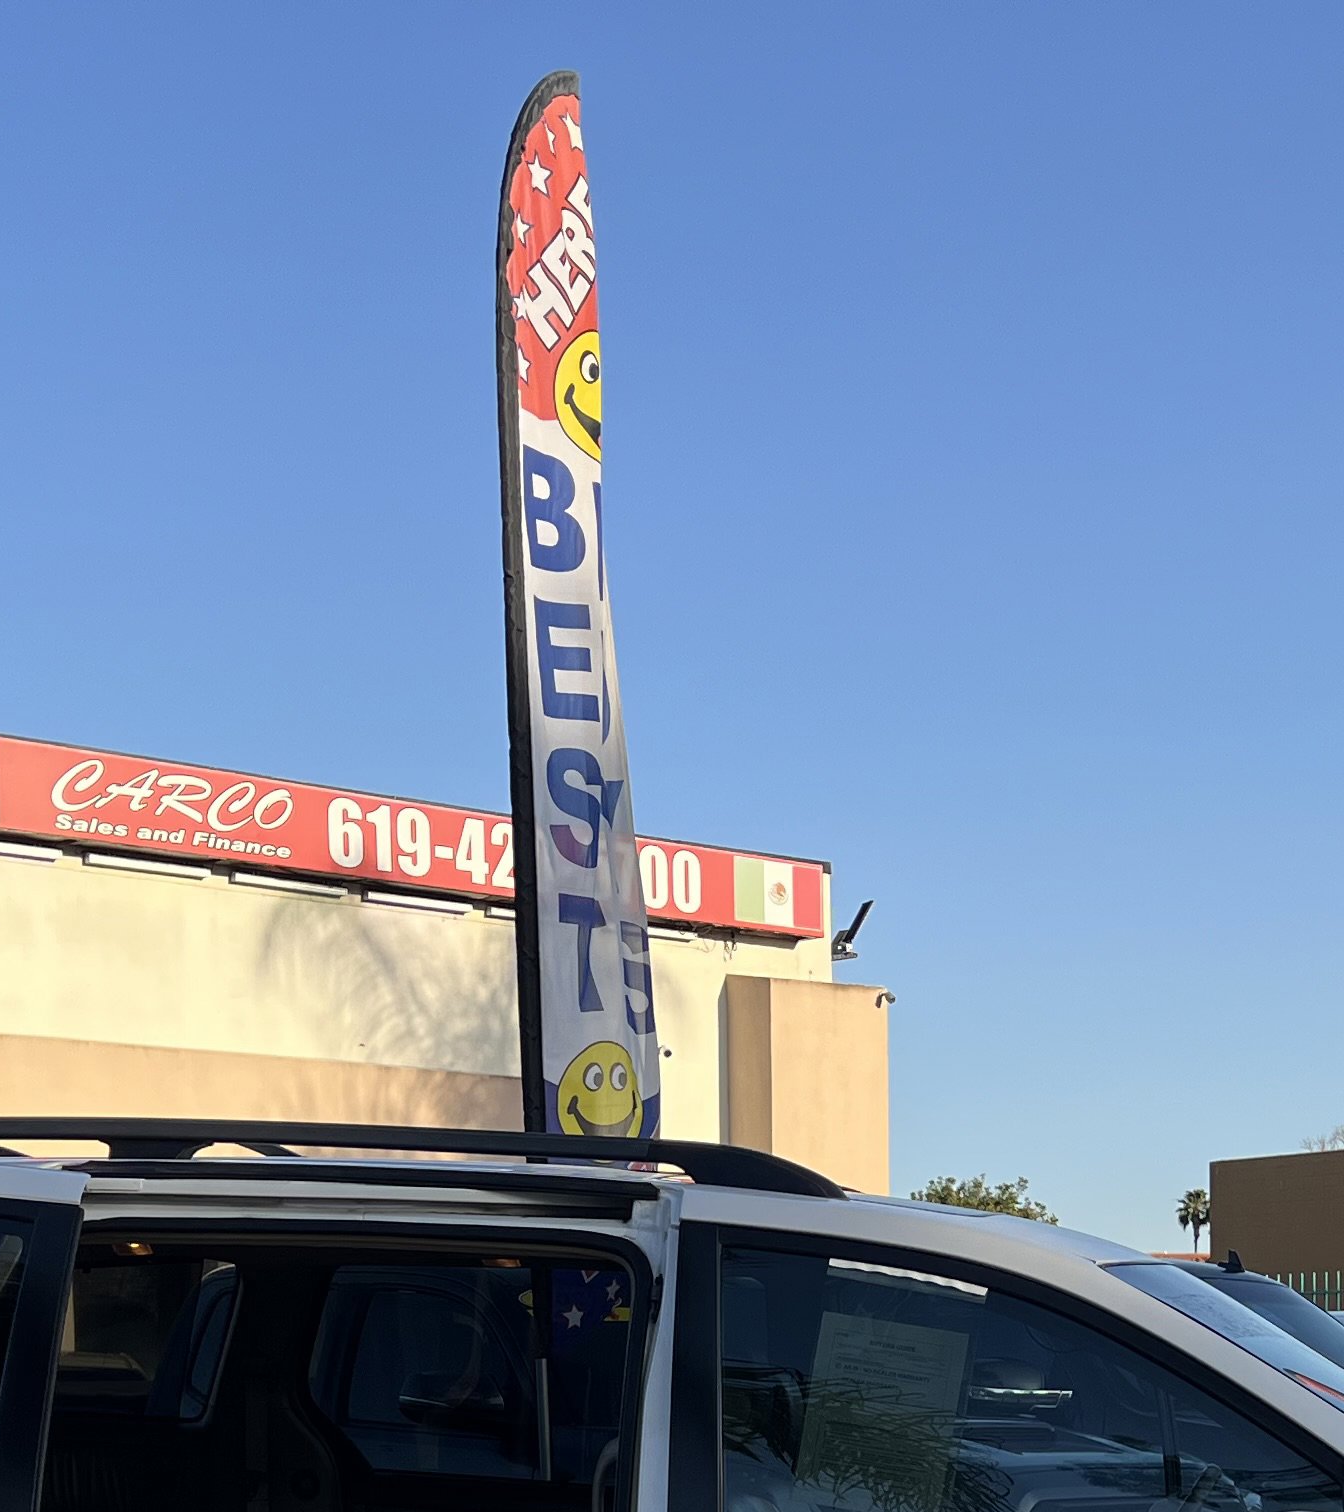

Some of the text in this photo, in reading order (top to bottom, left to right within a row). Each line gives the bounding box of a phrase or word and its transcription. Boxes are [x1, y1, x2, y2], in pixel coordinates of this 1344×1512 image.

[50, 759, 295, 832] CARCO
[54, 813, 293, 860] Sales and Finance
